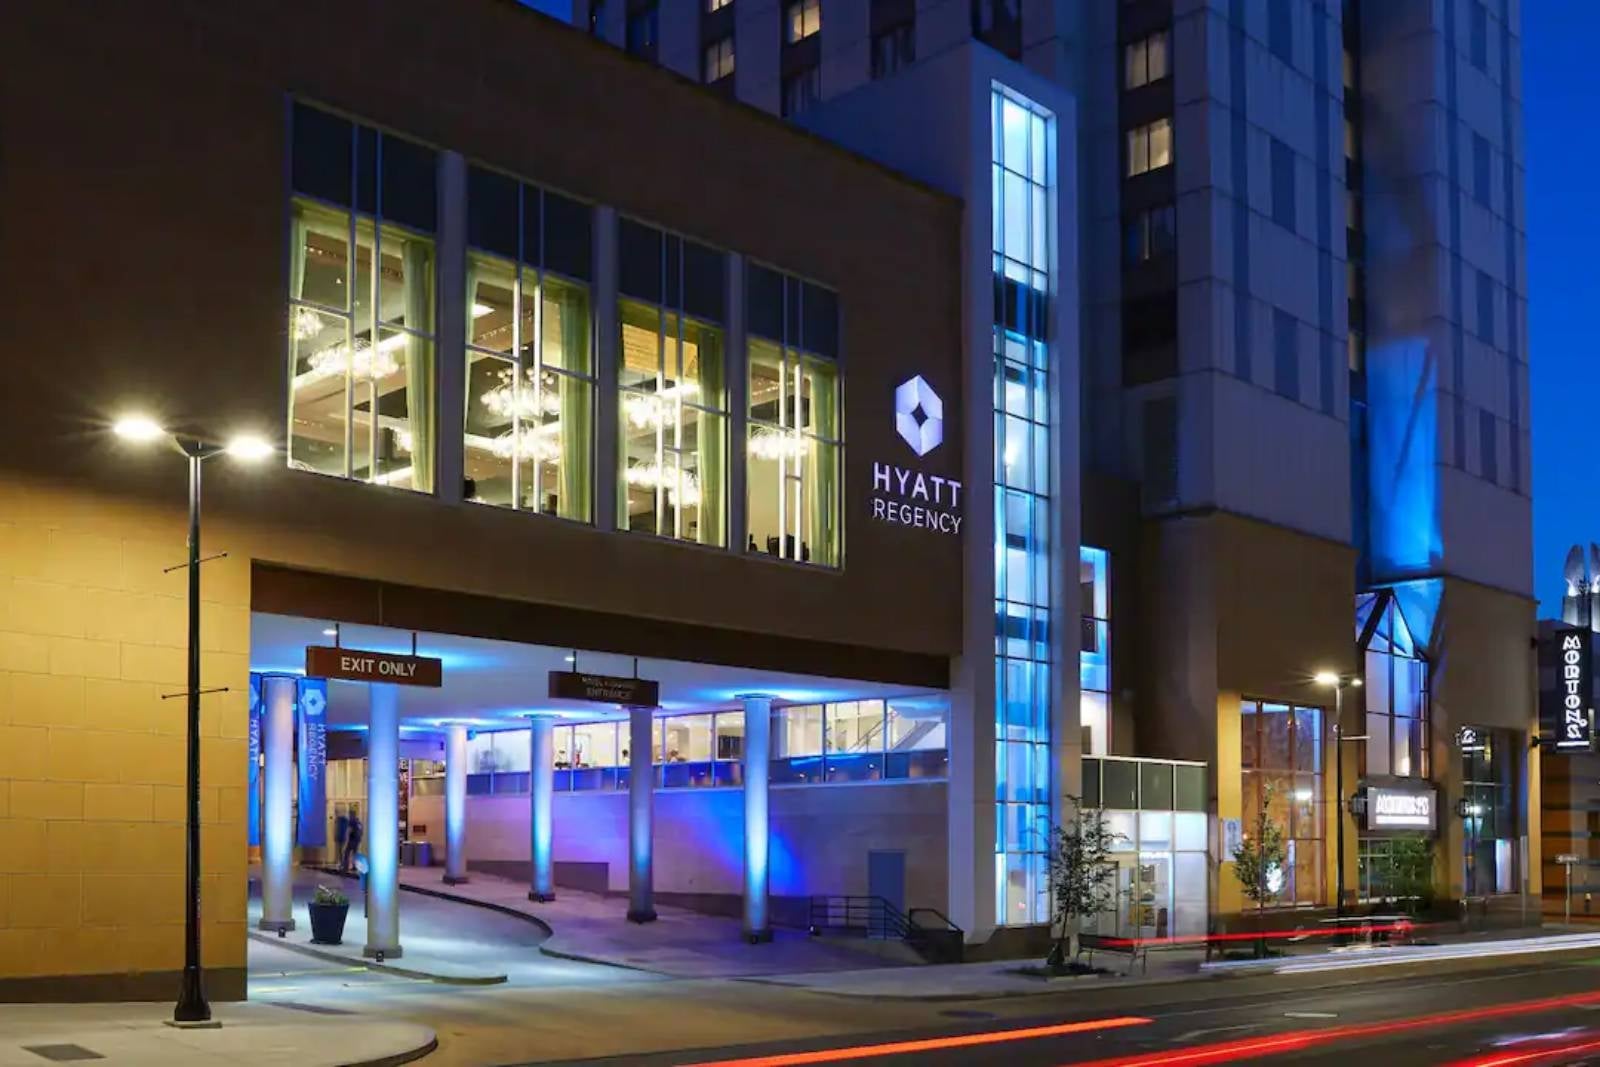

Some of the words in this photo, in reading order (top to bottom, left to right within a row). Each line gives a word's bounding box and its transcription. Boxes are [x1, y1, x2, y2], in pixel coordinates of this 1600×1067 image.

[873, 462, 962, 507] HYATT
[873, 499, 962, 534] REGENCY
[341, 657, 375, 673] EXIT
[379, 660, 417, 677] ONLY
[249, 719, 259, 762] HYATT
[307, 723, 318, 780] REGENCY
[317, 724, 326, 765] HYATT
